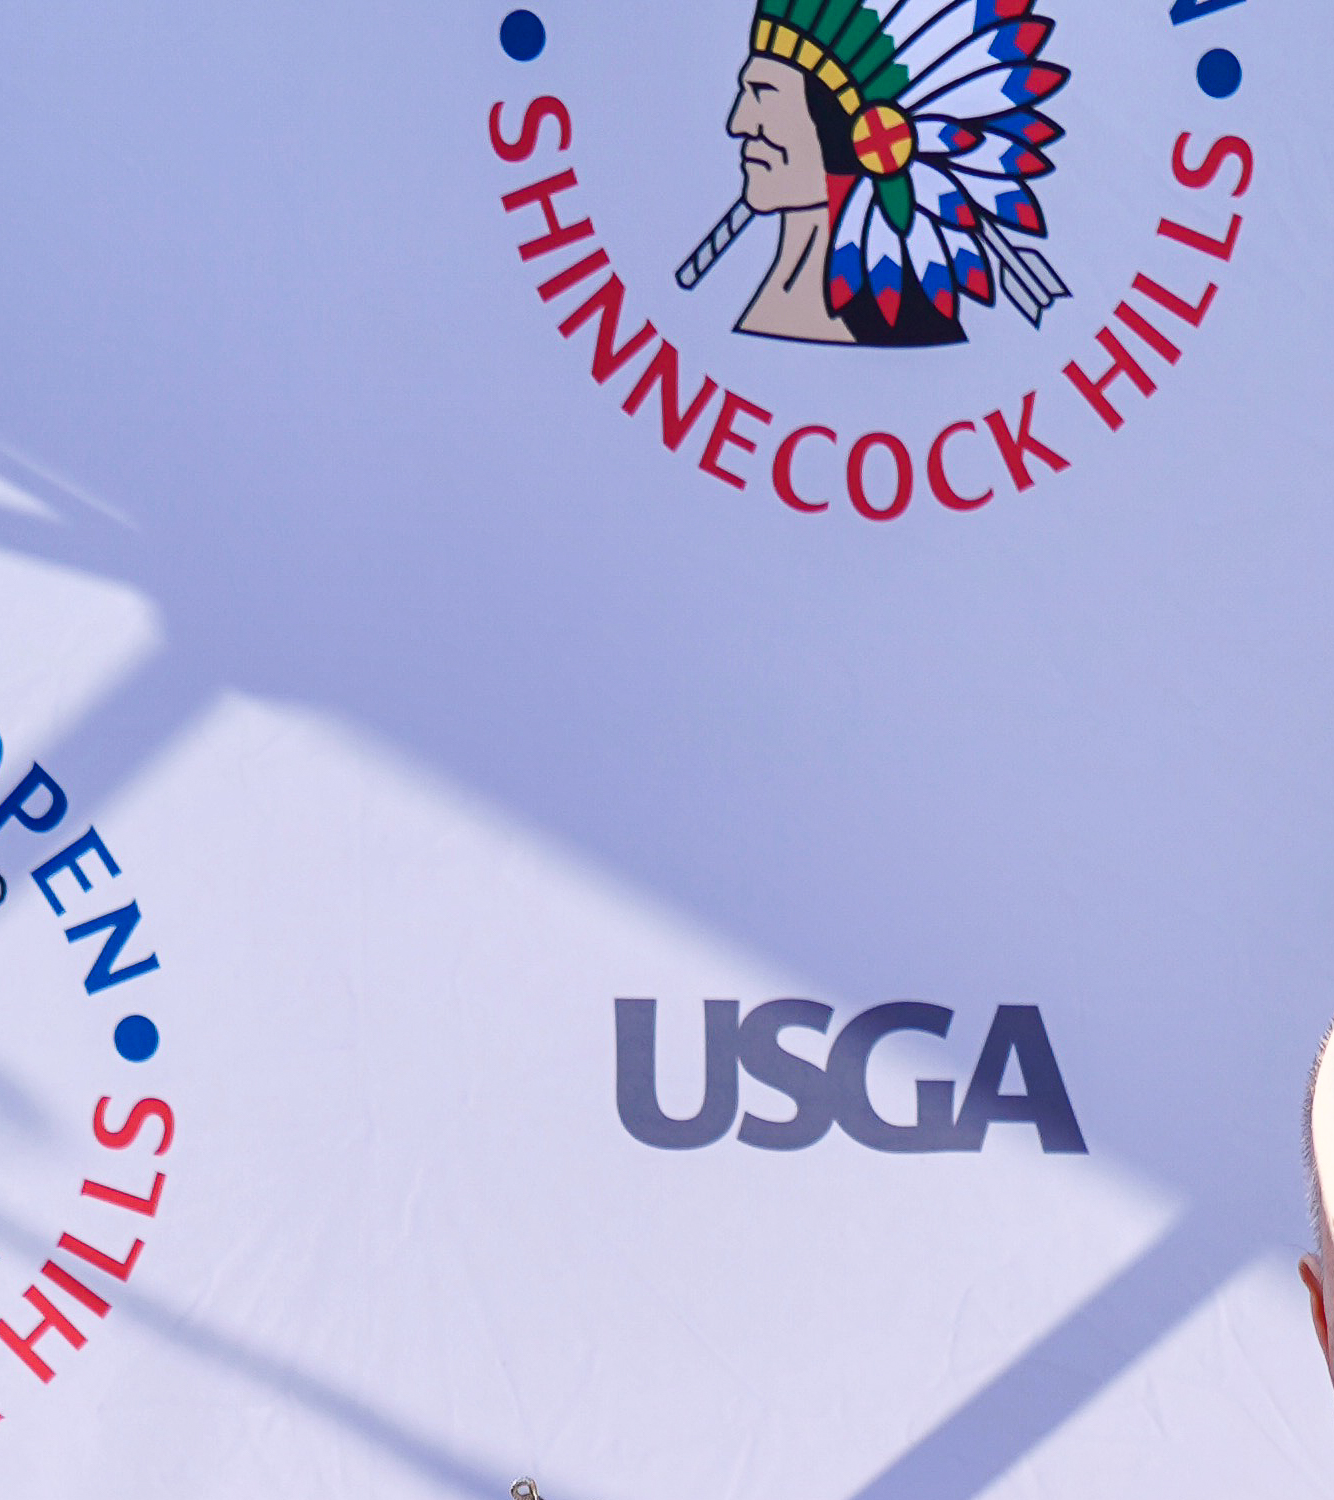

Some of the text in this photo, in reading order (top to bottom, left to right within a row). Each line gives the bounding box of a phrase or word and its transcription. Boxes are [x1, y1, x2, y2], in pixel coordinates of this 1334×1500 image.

[488, 95, 1254, 521] SHINNECOCK HILLS
[614, 998, 1089, 1154] USGA
